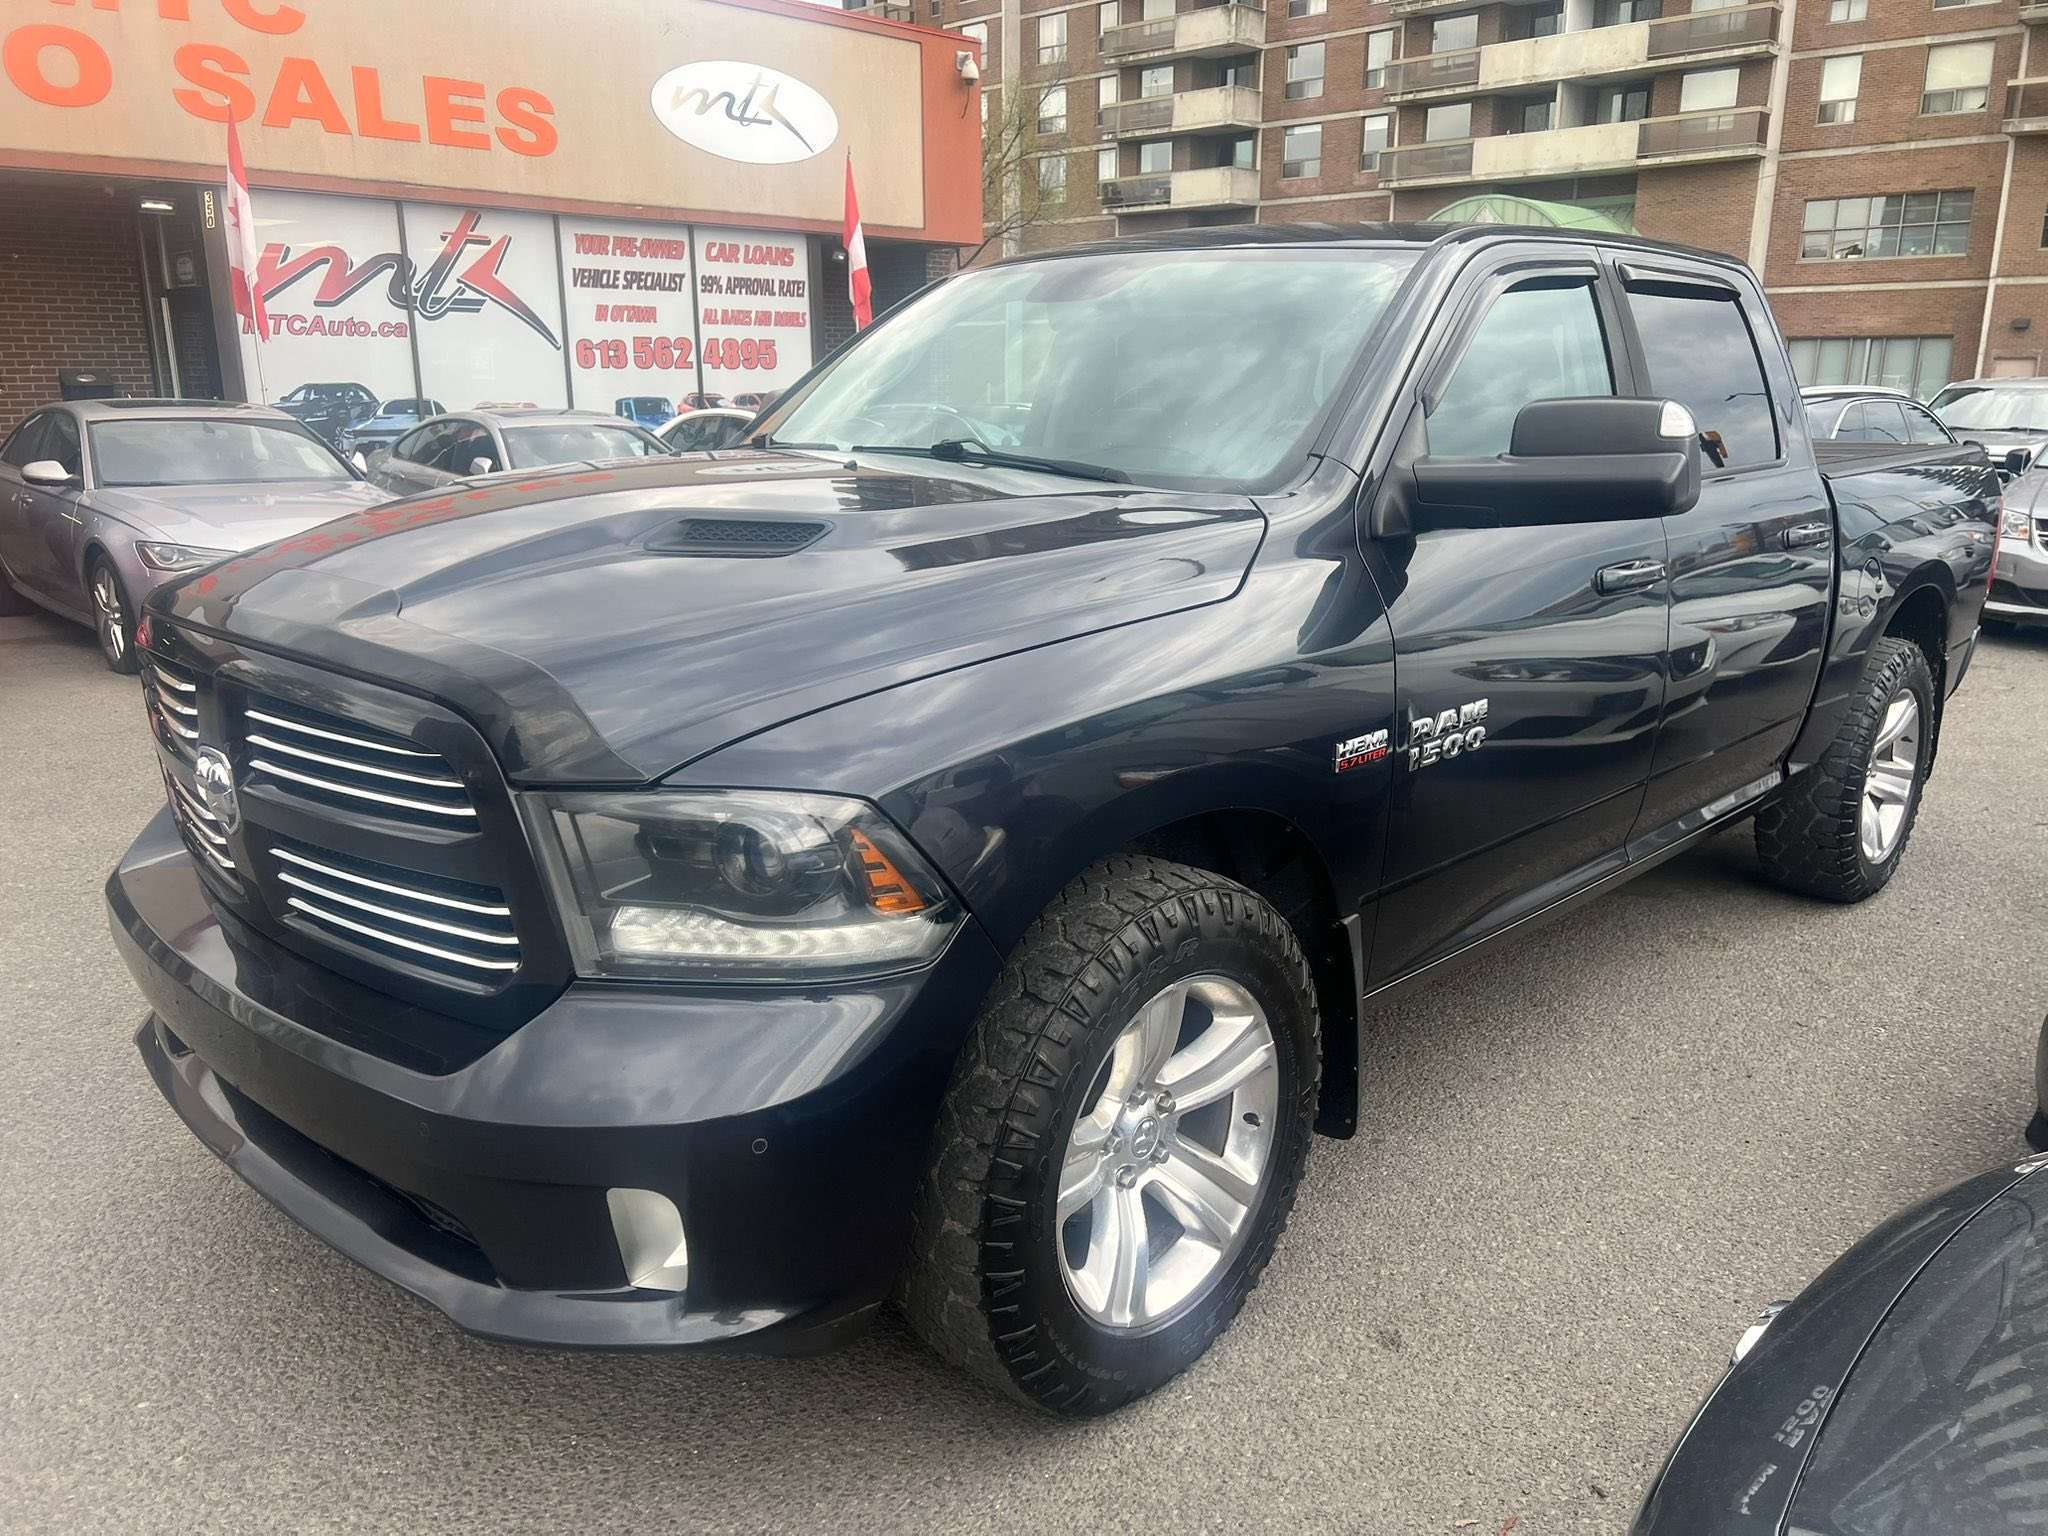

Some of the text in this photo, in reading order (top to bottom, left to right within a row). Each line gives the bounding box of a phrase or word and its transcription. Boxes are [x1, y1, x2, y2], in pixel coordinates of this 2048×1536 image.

[173, 42, 559, 157] SALES
[204, 191, 215, 228] 350
[574, 233, 685, 260] YOUR PRE-OWNED
[705, 242, 794, 267] CAR LOANS
[572, 267, 685, 293] VEHICLE SPECIALIST
[700, 275, 806, 298] 99% APPROVAL RATE!
[610, 305, 657, 323] OTTAWA
[703, 308, 719, 325] ALL
[575, 336, 778, 370] 613 562 4895
[1411, 698, 1488, 740] RAM
[1336, 728, 1389, 758] HEMI
[1409, 726, 1487, 773] 1500
